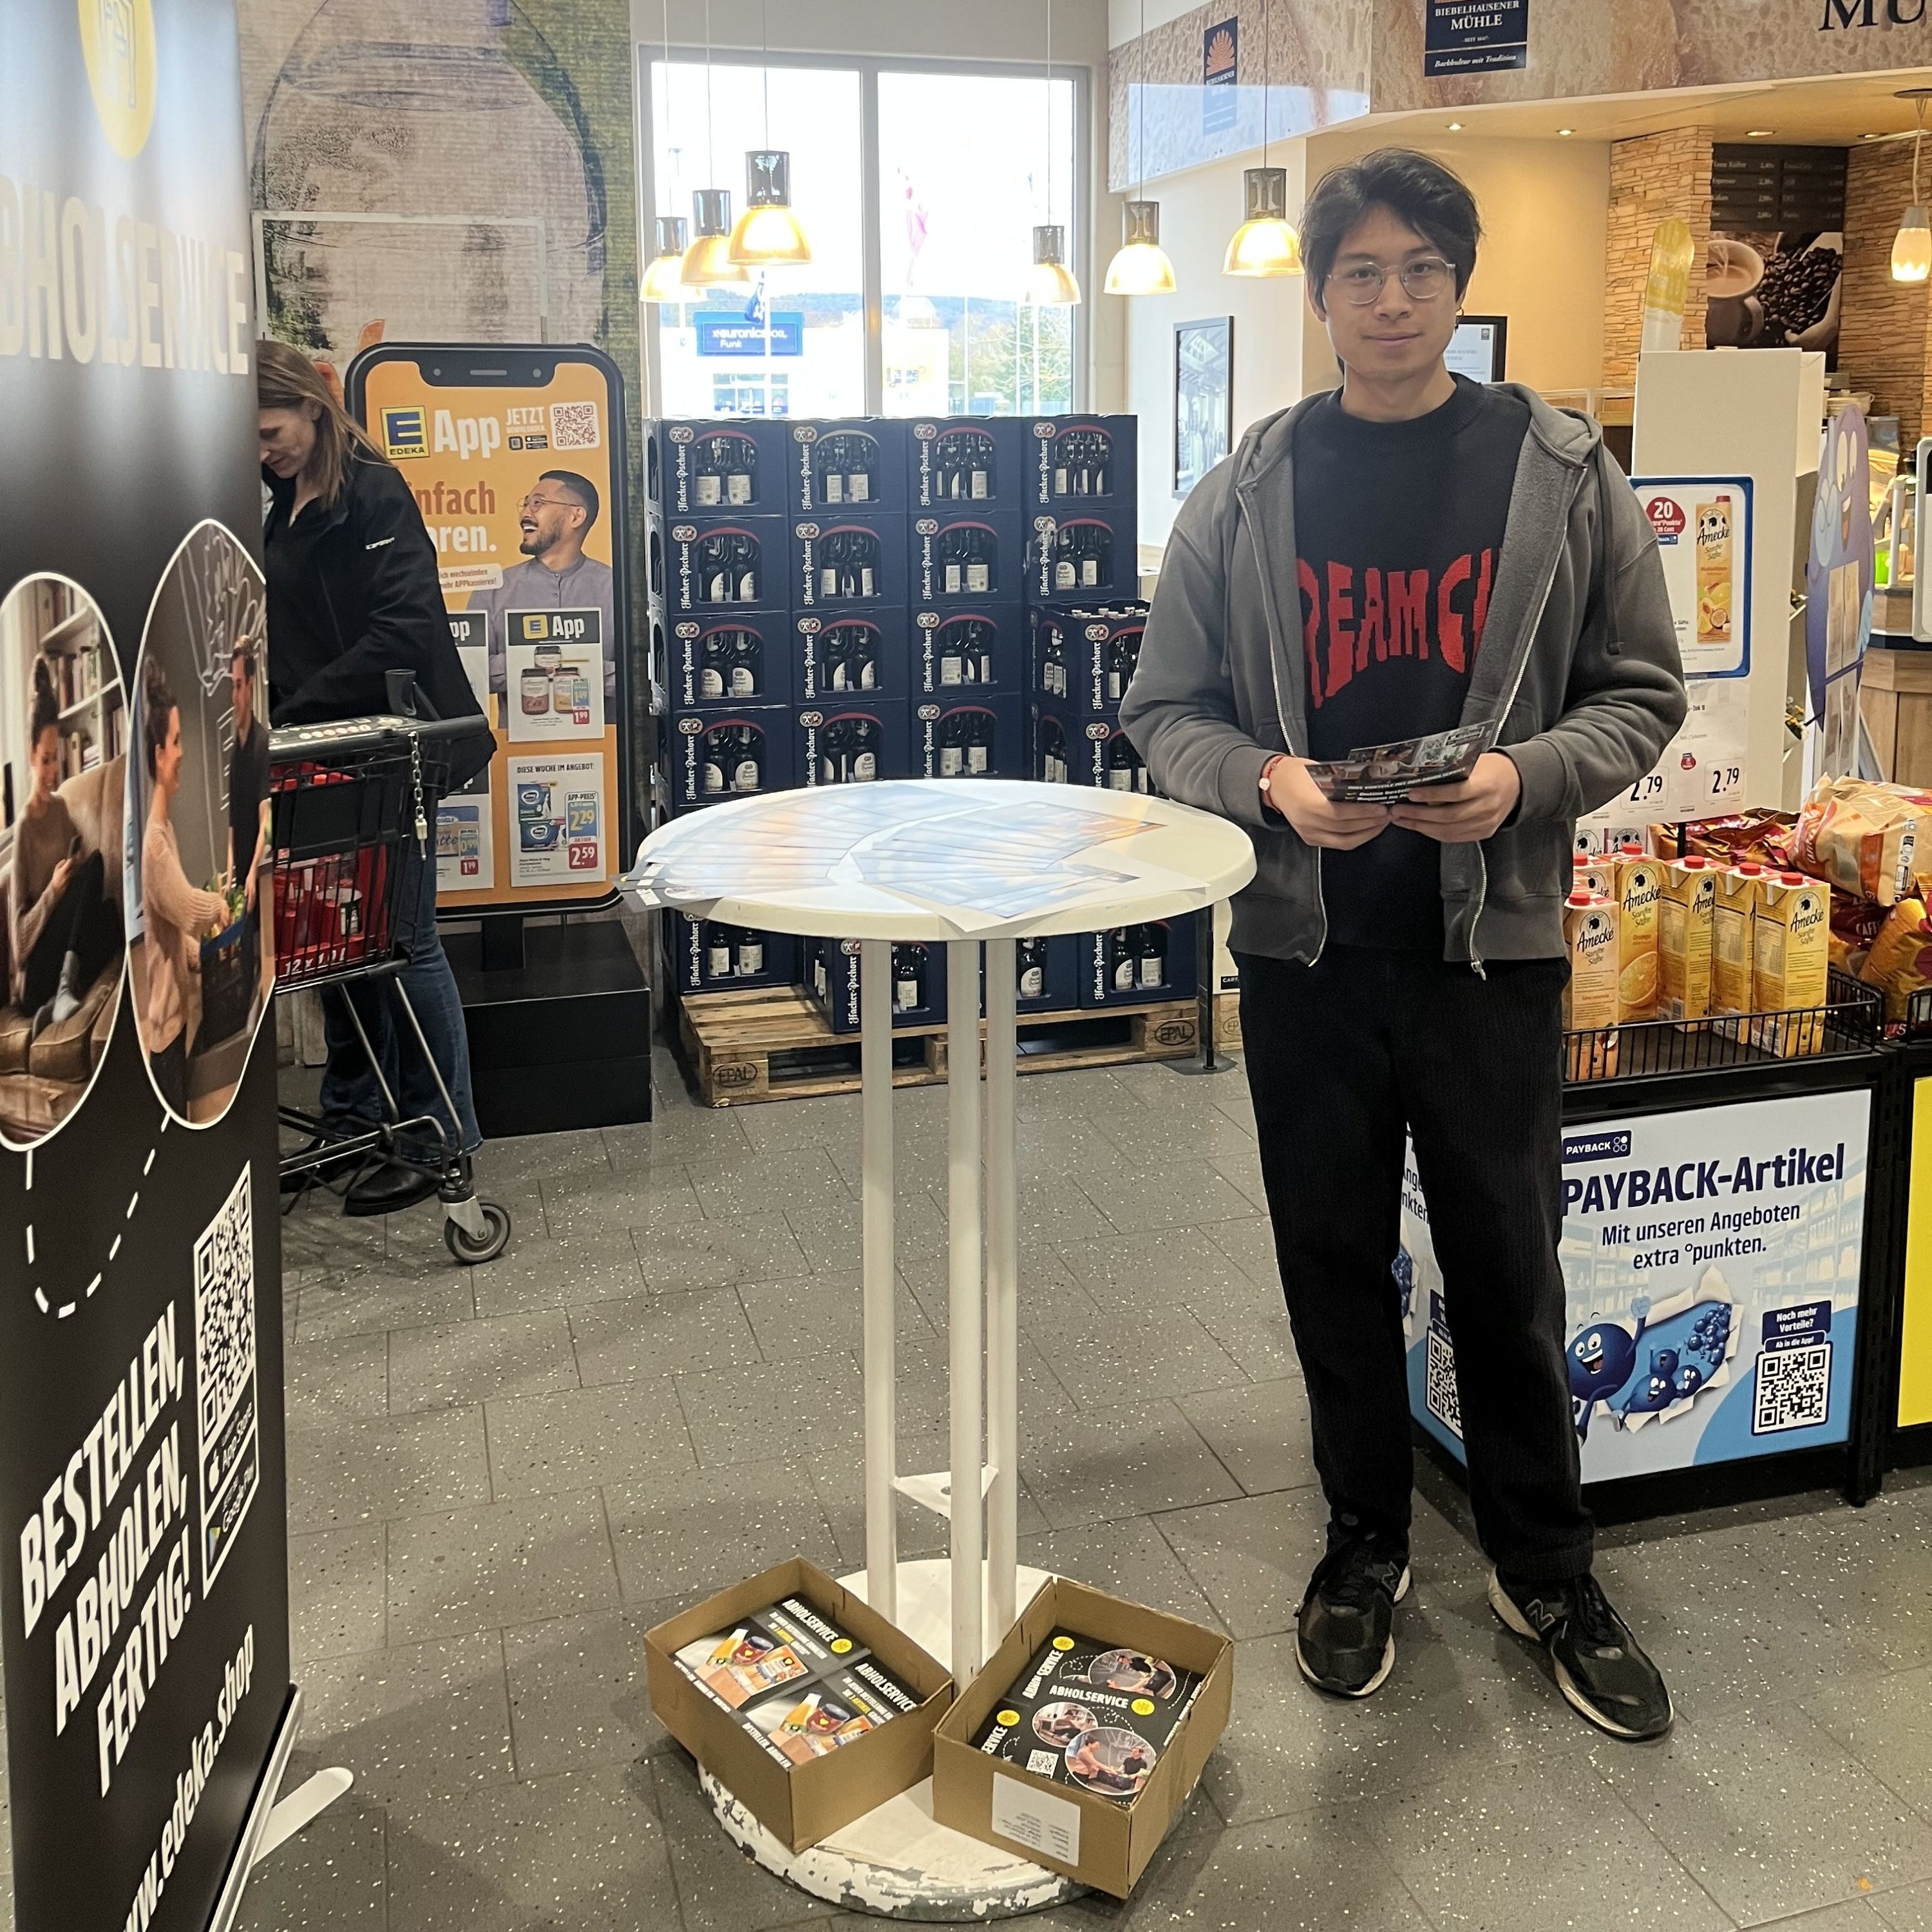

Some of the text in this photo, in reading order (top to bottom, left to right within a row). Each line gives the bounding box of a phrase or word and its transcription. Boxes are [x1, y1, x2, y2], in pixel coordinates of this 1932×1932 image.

[1435, 1, 1520, 17] BIEBELHAUSENER
[1450, 14, 1503, 30] MÜHLE
[1486, 54, 1517, 62] Tradition
[720, 339, 742, 348] Funk
[506, 406, 545, 426] JETZT
[435, 410, 500, 460] App
[406, 480, 495, 515] nfach
[1654, 501, 1674, 518] 20
[1697, 526, 1730, 546] Amecke
[450, 620, 471, 641] pp
[553, 616, 585, 639] App
[517, 764, 534, 773] DIESE
[535, 764, 556, 773] WOCHE
[1712, 768, 1739, 793] 2.79
[1630, 775, 1663, 802] 2.79
[571, 846, 596, 866] 2.59
[1623, 884, 1662, 912] Amecke
[1790, 908, 1824, 933] Amecke
[1577, 927, 1615, 953] Amecke
[1227, 1020, 1239, 1030] EP
[1566, 1141, 1611, 1155] PAYBACK
[1562, 1142, 1845, 1217] PAYBACK-Artikel
[1602, 1204, 1801, 1246] Mit unseren Angeboten
[1633, 1237, 1768, 1270] extra °punkten.
[1776, 1307, 1817, 1323] Noch mehr
[1779, 1318, 1814, 1333] Vorteile?
[20, 1300, 185, 1639] BESTELLEN,
[56, 1419, 188, 1738] ABHOLEN,
[782, 1598, 838, 1642] ABHOLSERVICE
[97, 1524, 191, 1798] FERTIG!
[855, 1663, 918, 1713] ABHOLSERVICE
[1049, 1685, 1129, 1709] ABHOLSERVICE
